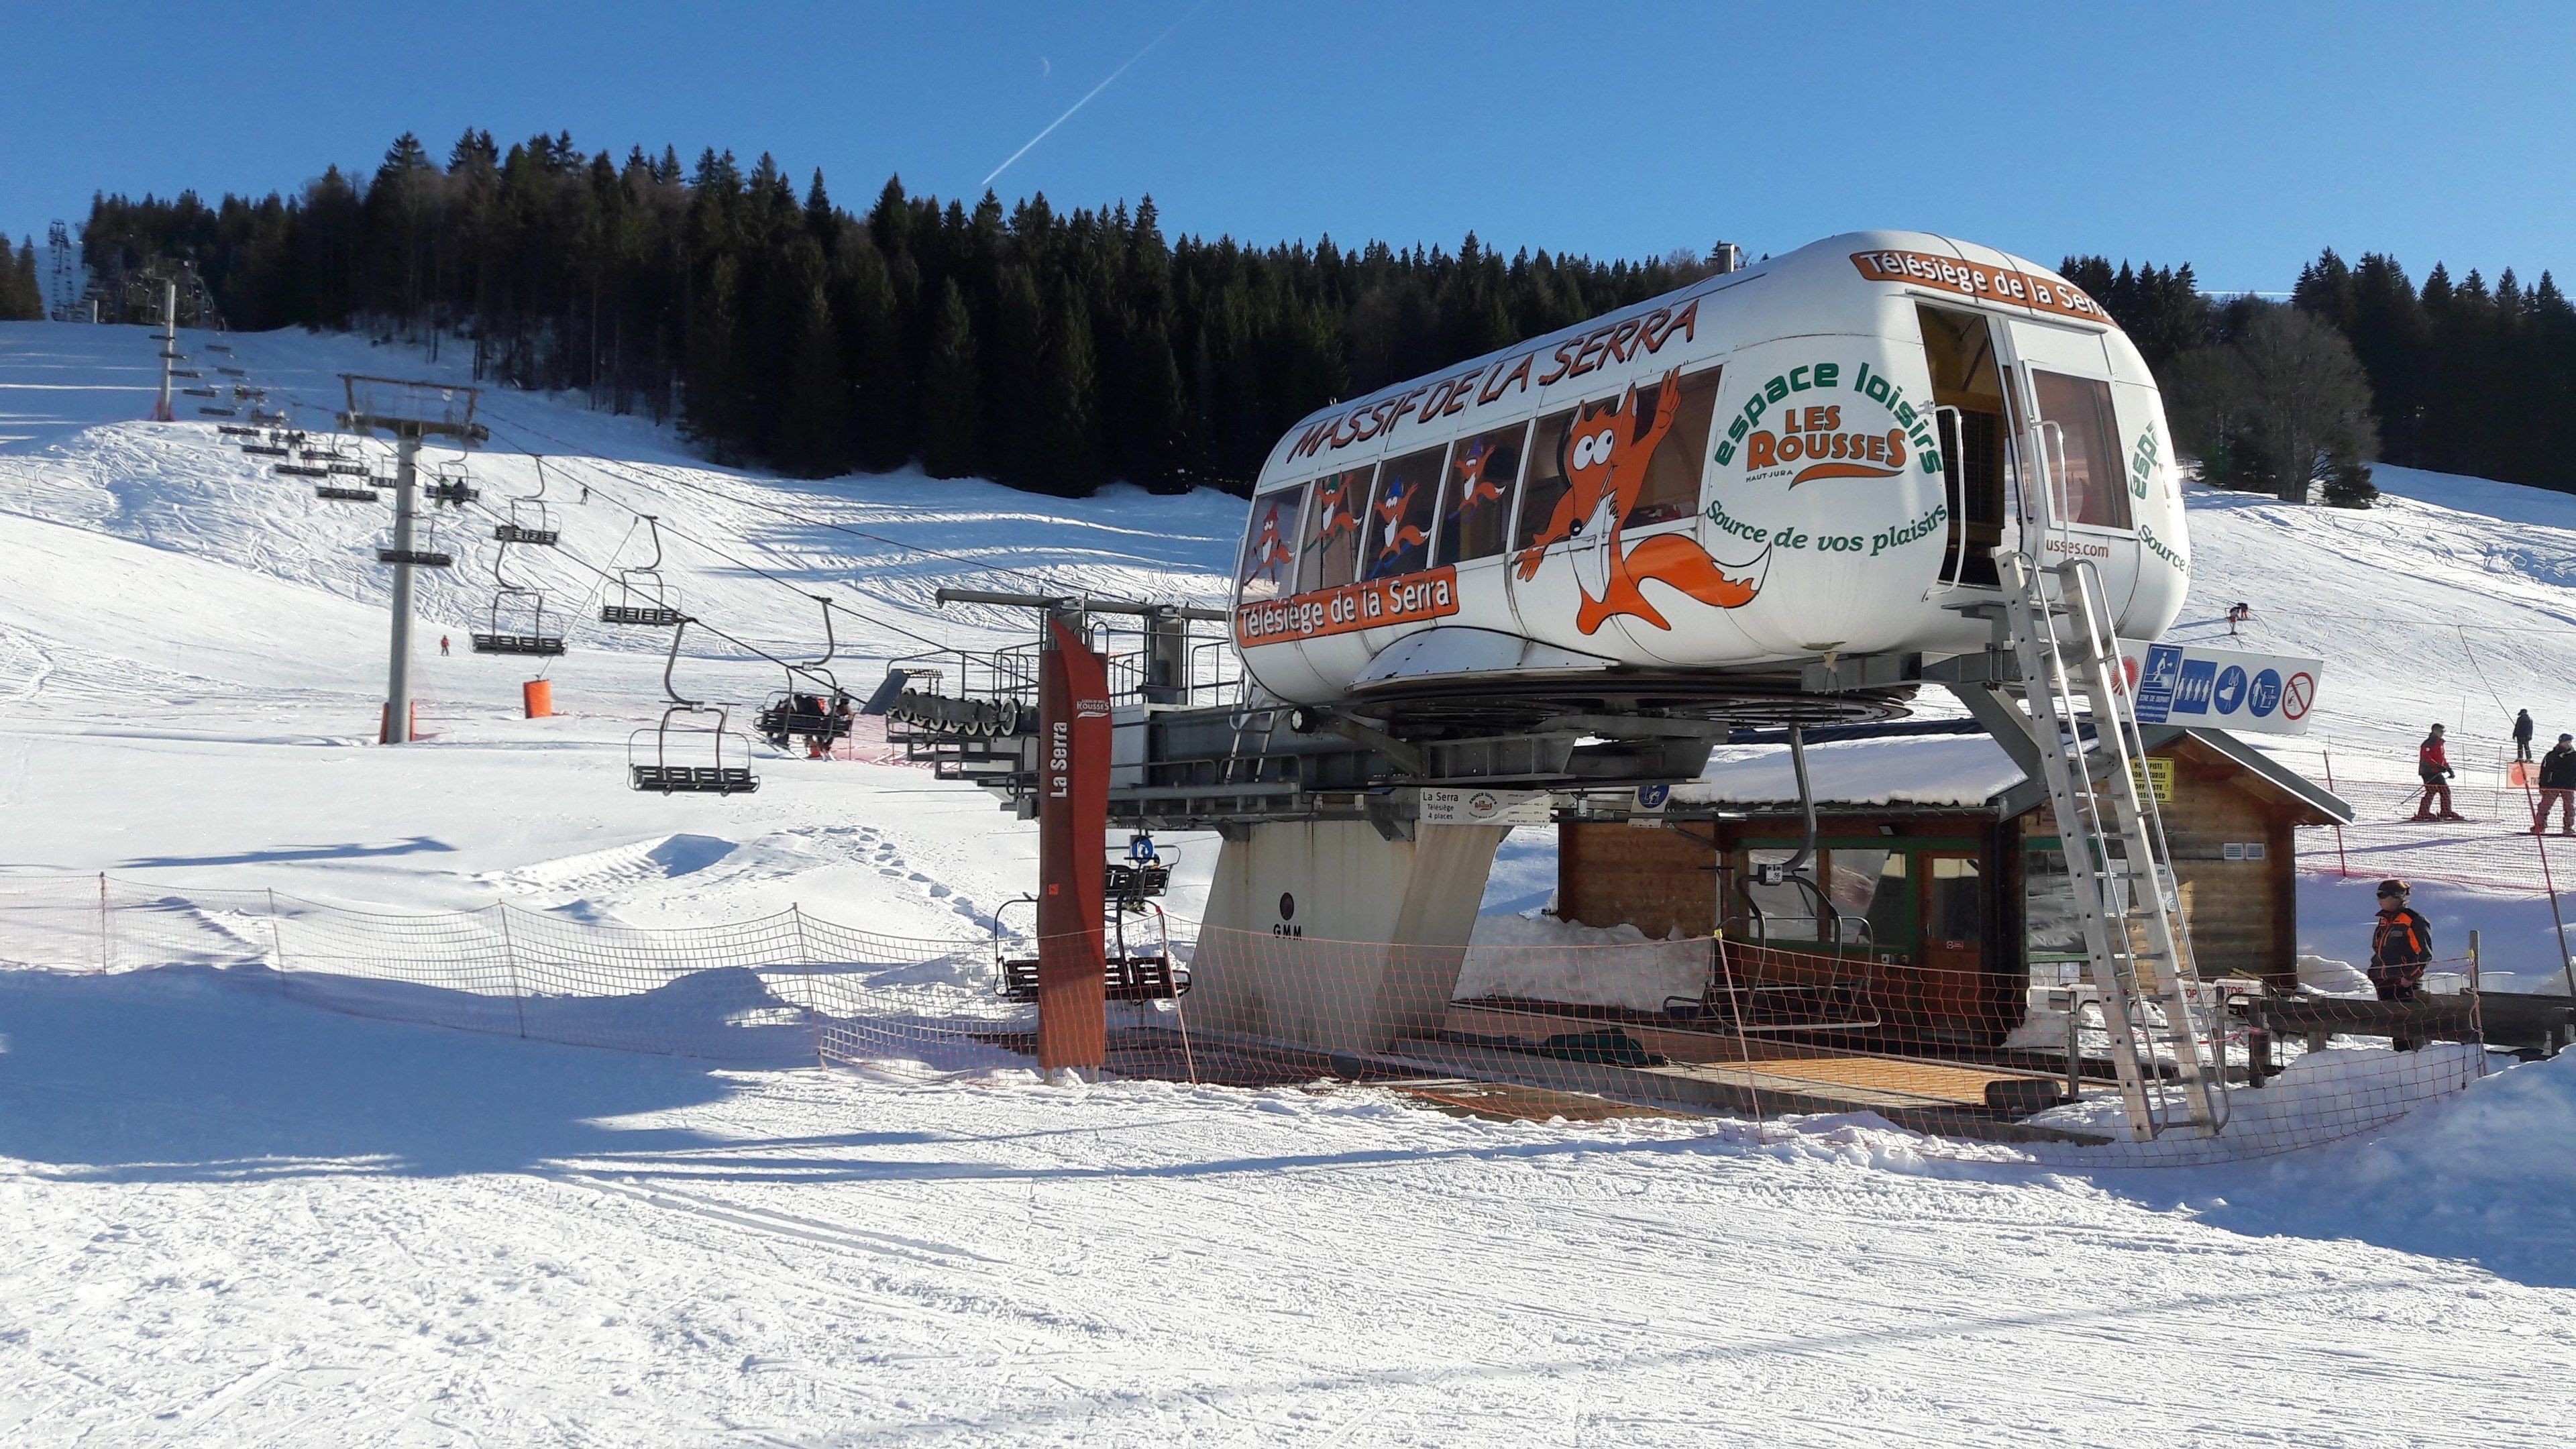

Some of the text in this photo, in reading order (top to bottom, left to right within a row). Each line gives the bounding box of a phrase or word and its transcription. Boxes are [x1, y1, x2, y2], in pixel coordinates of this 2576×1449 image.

[1860, 253, 1989, 293] Télésiège
[1993, 271, 2025, 299] de
[2027, 276, 2053, 305] la
[1287, 299, 1700, 464] MASSIF DE LA SERRA
[1714, 362, 1943, 474] espace loisirs
[1785, 405, 1841, 435] LES
[1746, 428, 1907, 472] ROUSSES
[1746, 470, 1793, 483] HAUT-JURA
[1706, 500, 1947, 557] Source de vos plaisirs
[2139, 525, 2186, 572] Source
[1240, 579, 1451, 638] Télésiège de la Serra
[1076, 700, 1110, 711] ROUSSES
[1050, 722, 1067, 798] La Serra
[1423, 792, 1459, 802] La Serra
[1427, 804, 1454, 812] Télésiège
[1434, 812, 1454, 820] places
[1273, 923, 1302, 941] GMM
[2224, 985, 2244, 996] TOP
